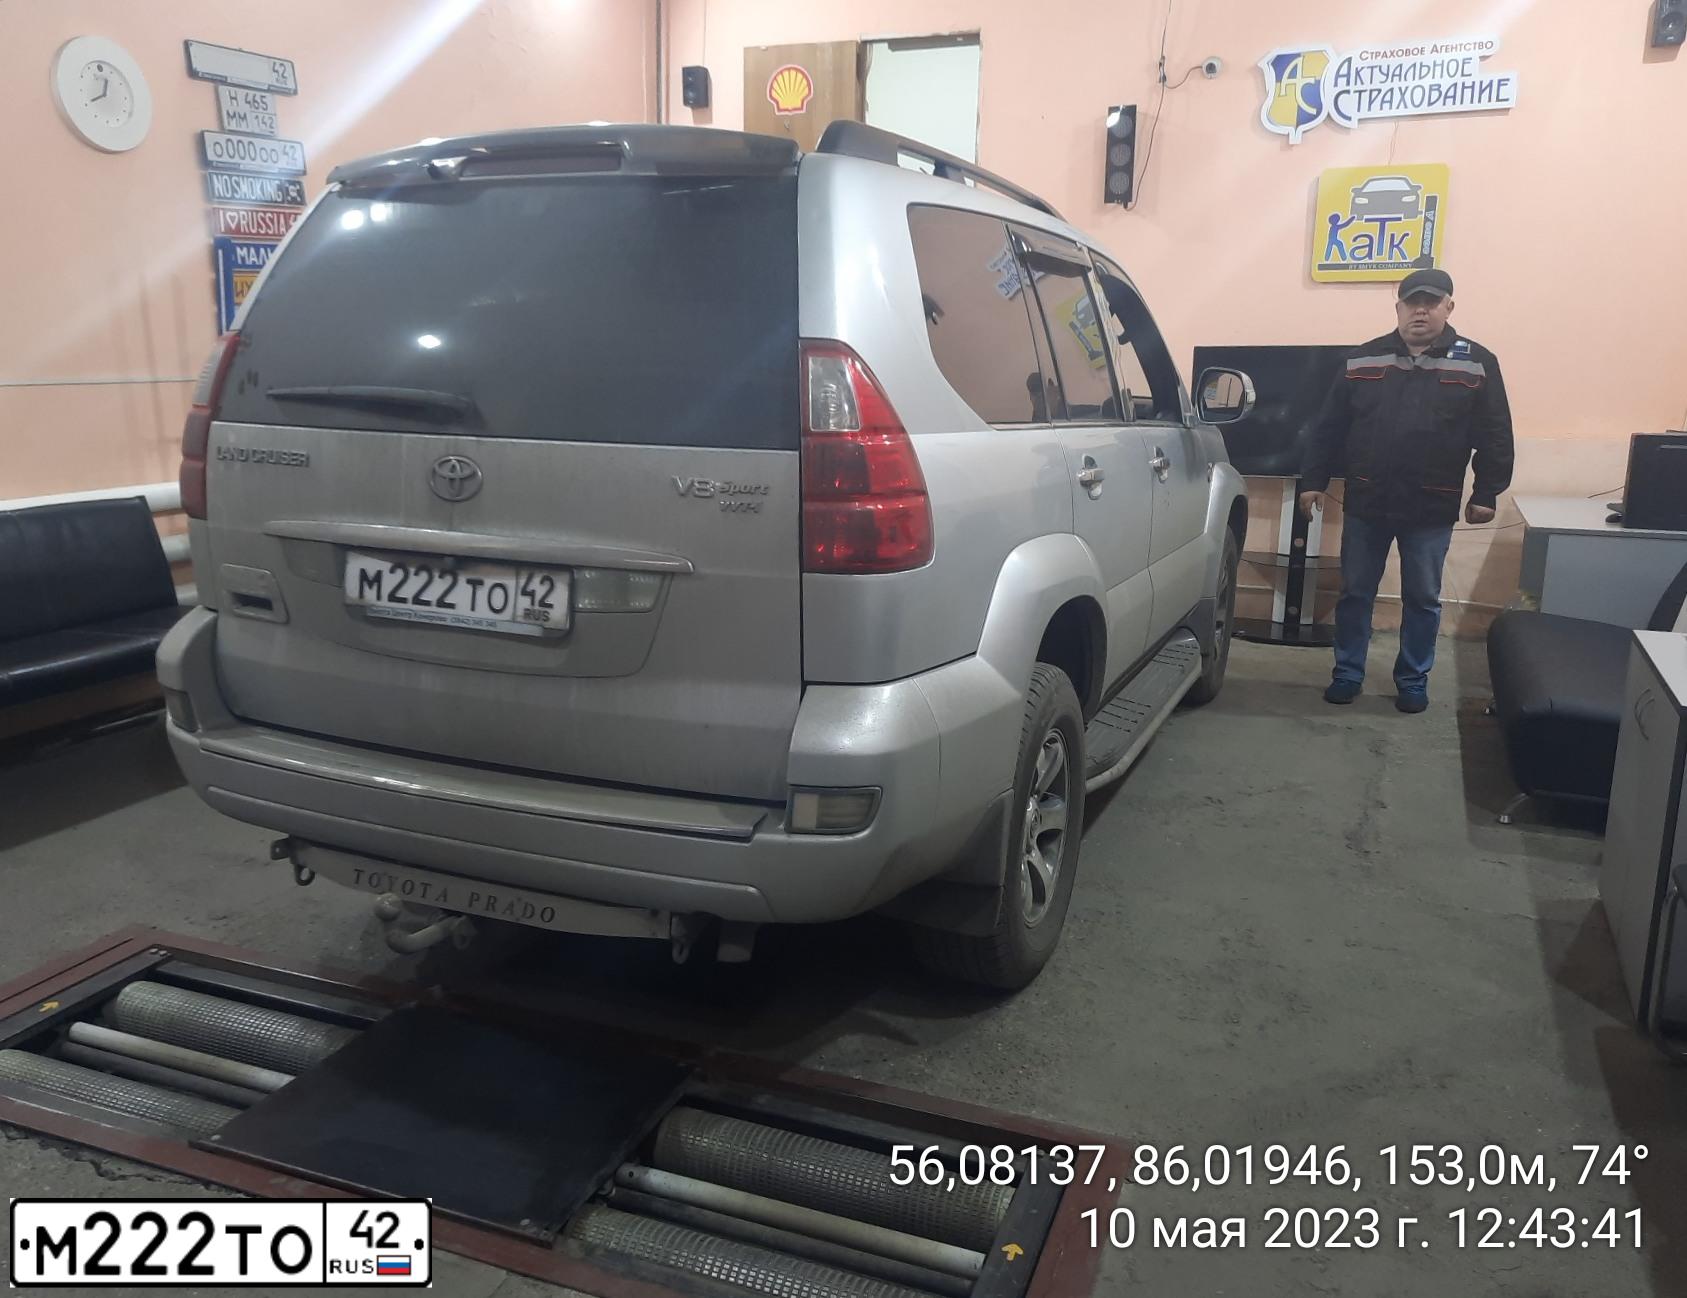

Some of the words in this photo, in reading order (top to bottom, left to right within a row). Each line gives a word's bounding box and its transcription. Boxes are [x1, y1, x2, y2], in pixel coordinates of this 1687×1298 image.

[272, 61, 288, 80] 42
[1333, 56, 1473, 88] АКТУАЛЬНОЕ
[244, 92, 268, 111] 465
[1333, 78, 1511, 122] СТРАХОВАНИЕ
[226, 109, 249, 128] ММ
[254, 114, 275, 130] 142
[282, 143, 298, 161] 42
[240, 210, 287, 235] RUSSIA
[216, 446, 249, 463] LAND
[251, 449, 310, 467] CRUISER
[671, 475, 716, 498] V8
[358, 561, 509, 614] М222ТО
[520, 572, 556, 609] 42
[524, 608, 551, 622] RUS
[353, 868, 449, 903] TOYOTA
[468, 891, 556, 924] PRADO
